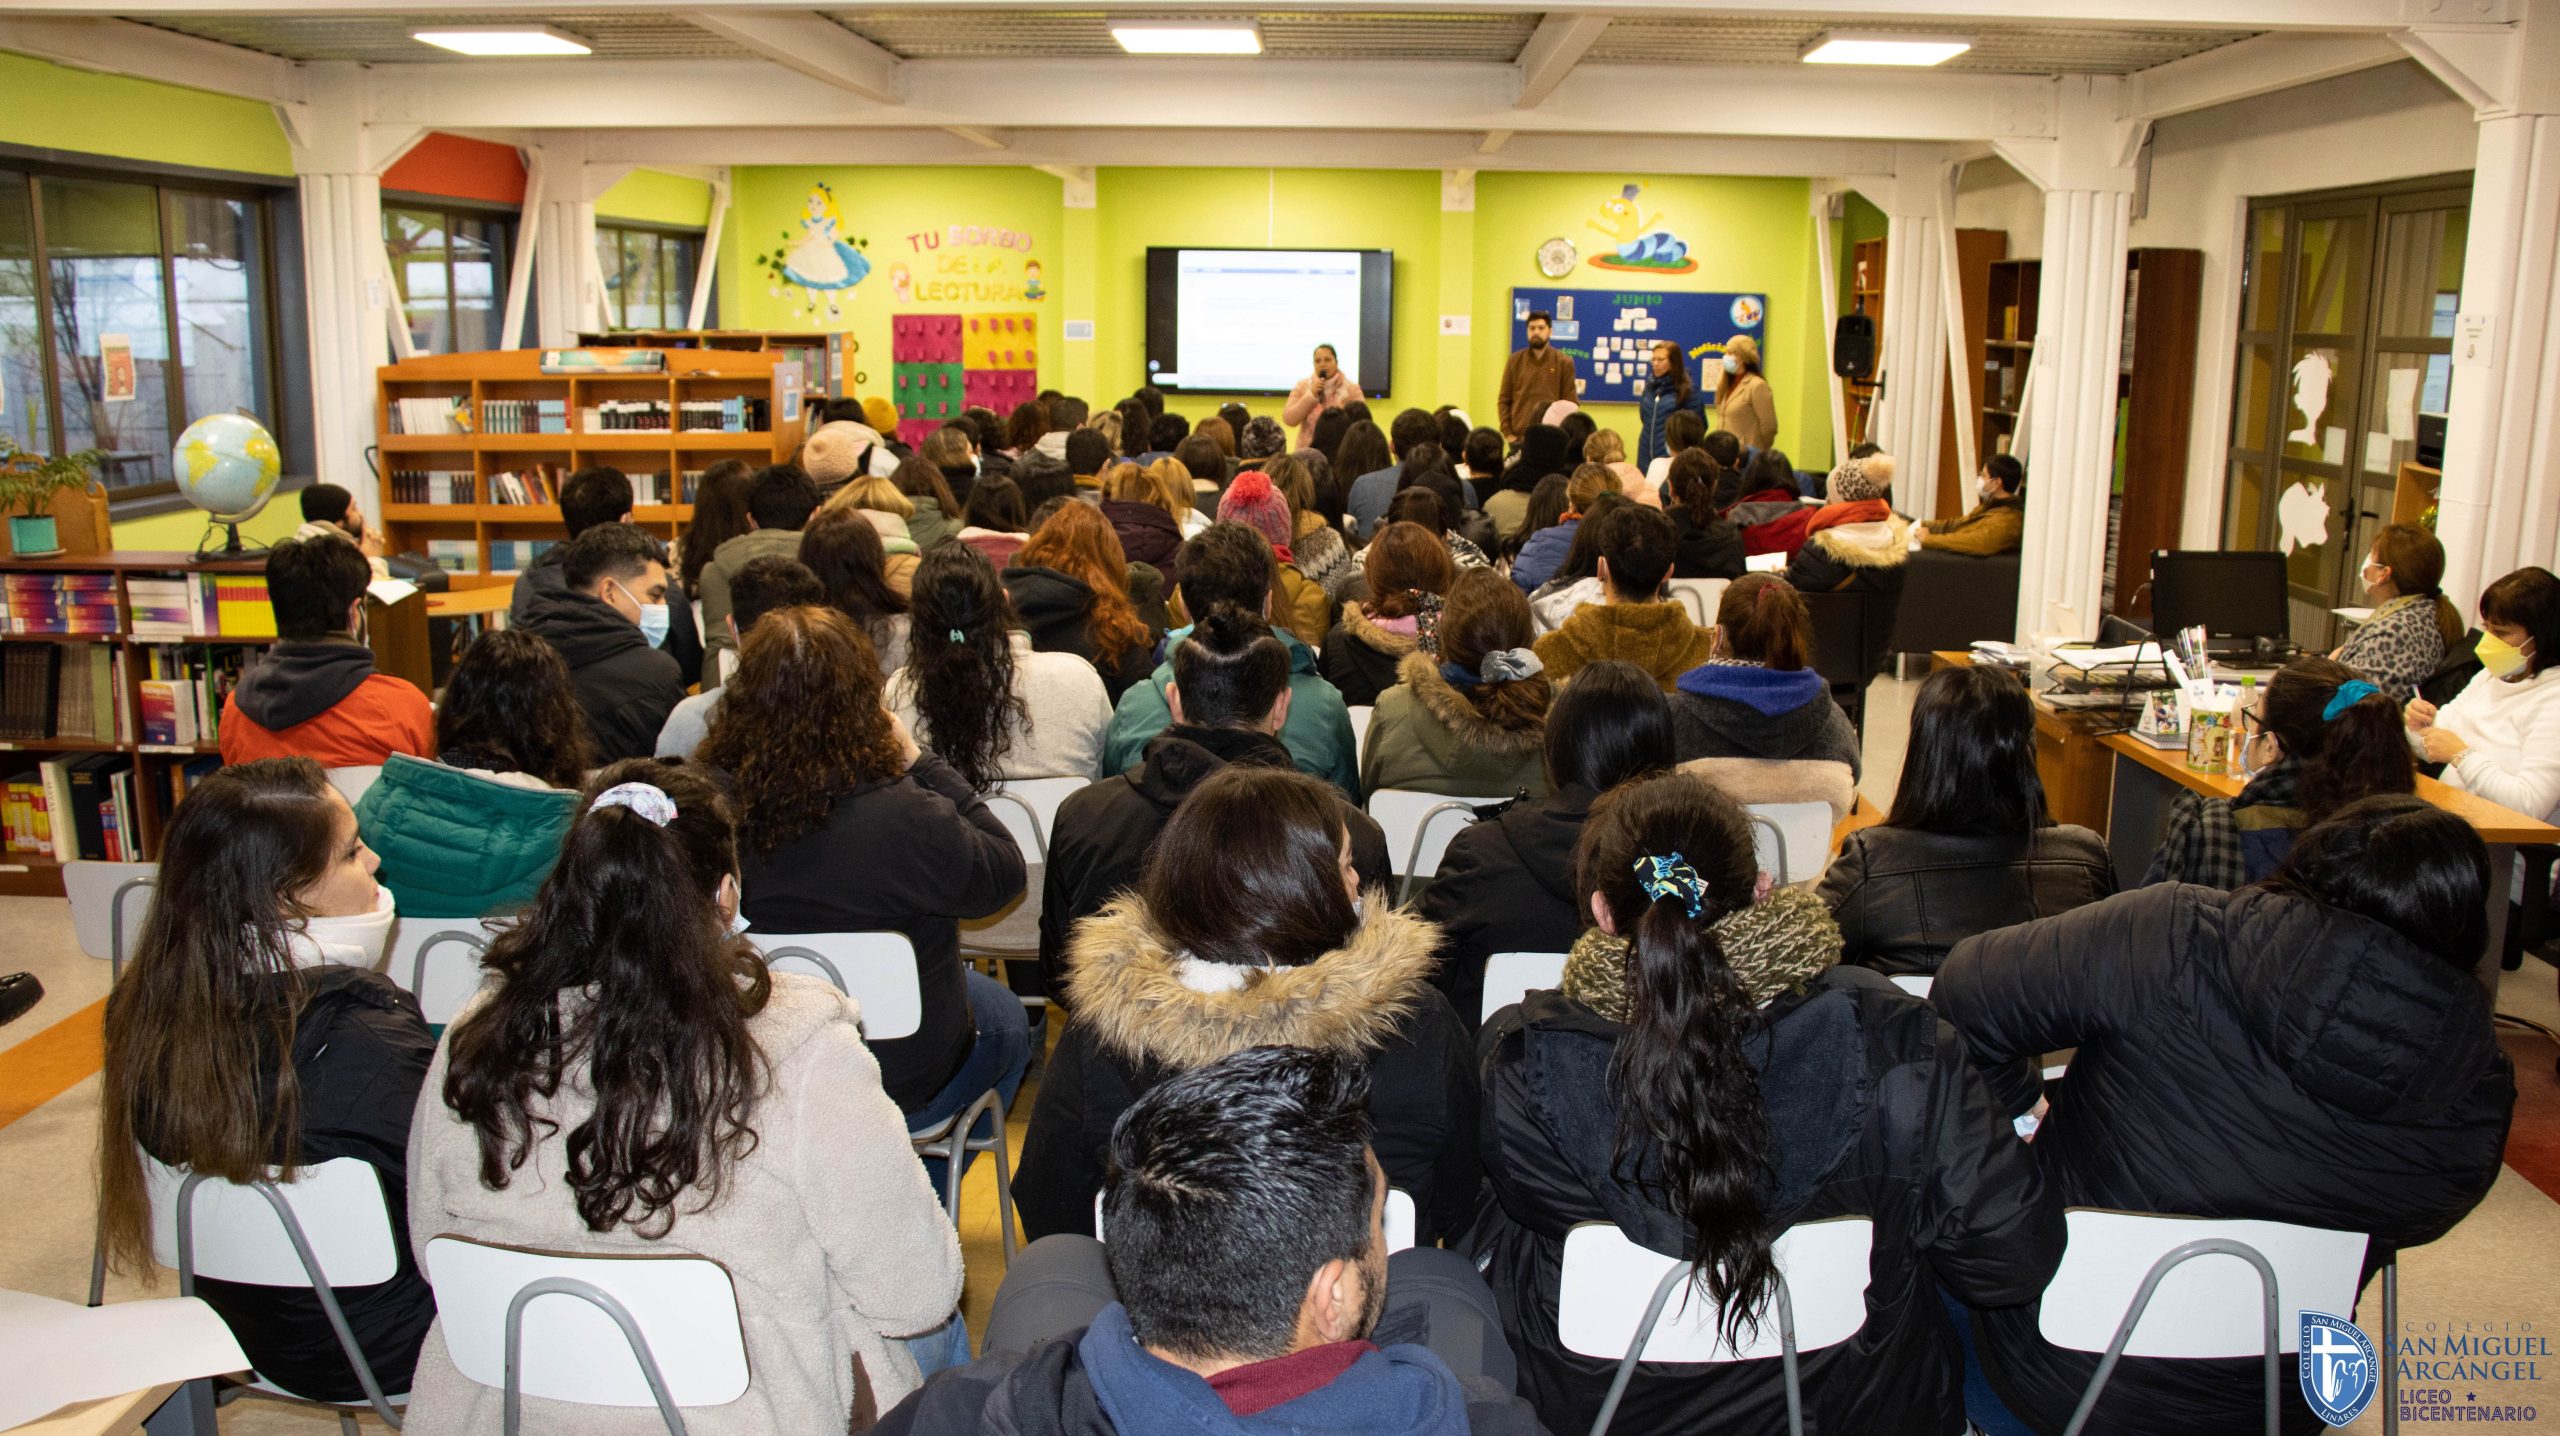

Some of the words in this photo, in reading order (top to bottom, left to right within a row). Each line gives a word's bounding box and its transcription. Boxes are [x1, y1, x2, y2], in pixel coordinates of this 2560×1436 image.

[907, 231, 939, 253] TU
[937, 254, 967, 274] DE
[915, 282, 1023, 302] LECTURA
[1612, 293, 1663, 305] JUNIO
